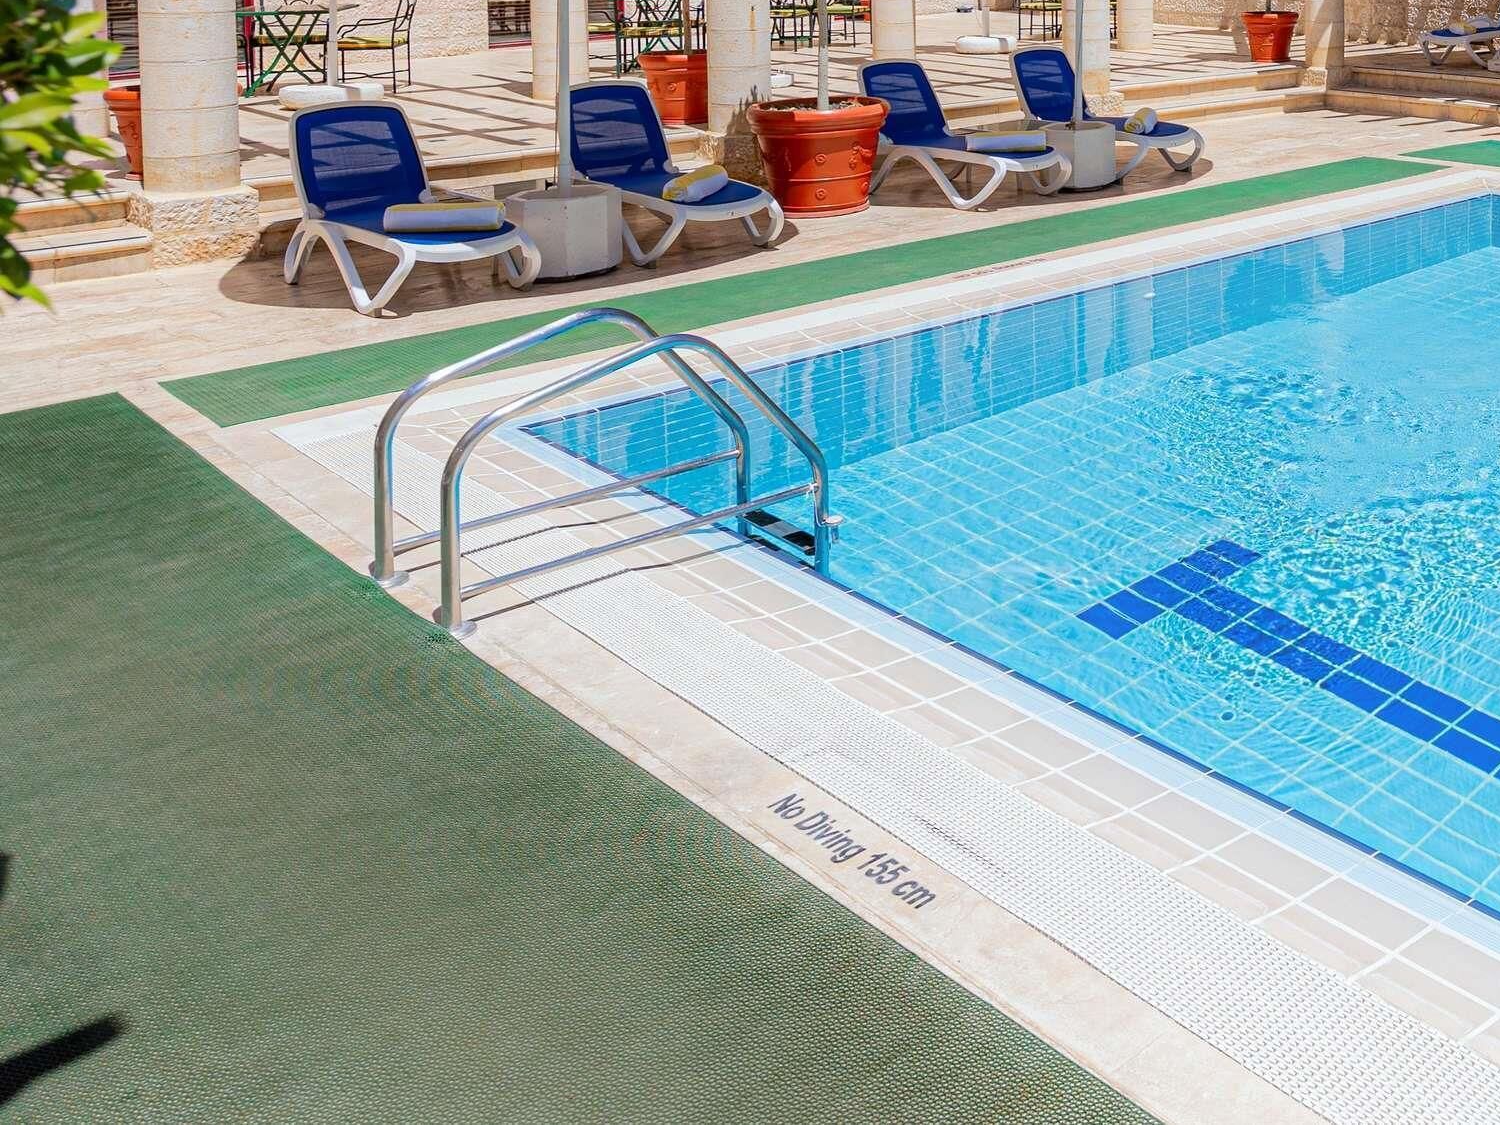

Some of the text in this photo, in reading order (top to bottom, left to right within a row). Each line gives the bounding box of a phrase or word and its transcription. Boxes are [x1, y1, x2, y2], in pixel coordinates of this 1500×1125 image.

[767, 793, 937, 909] No Diving 155 cm
